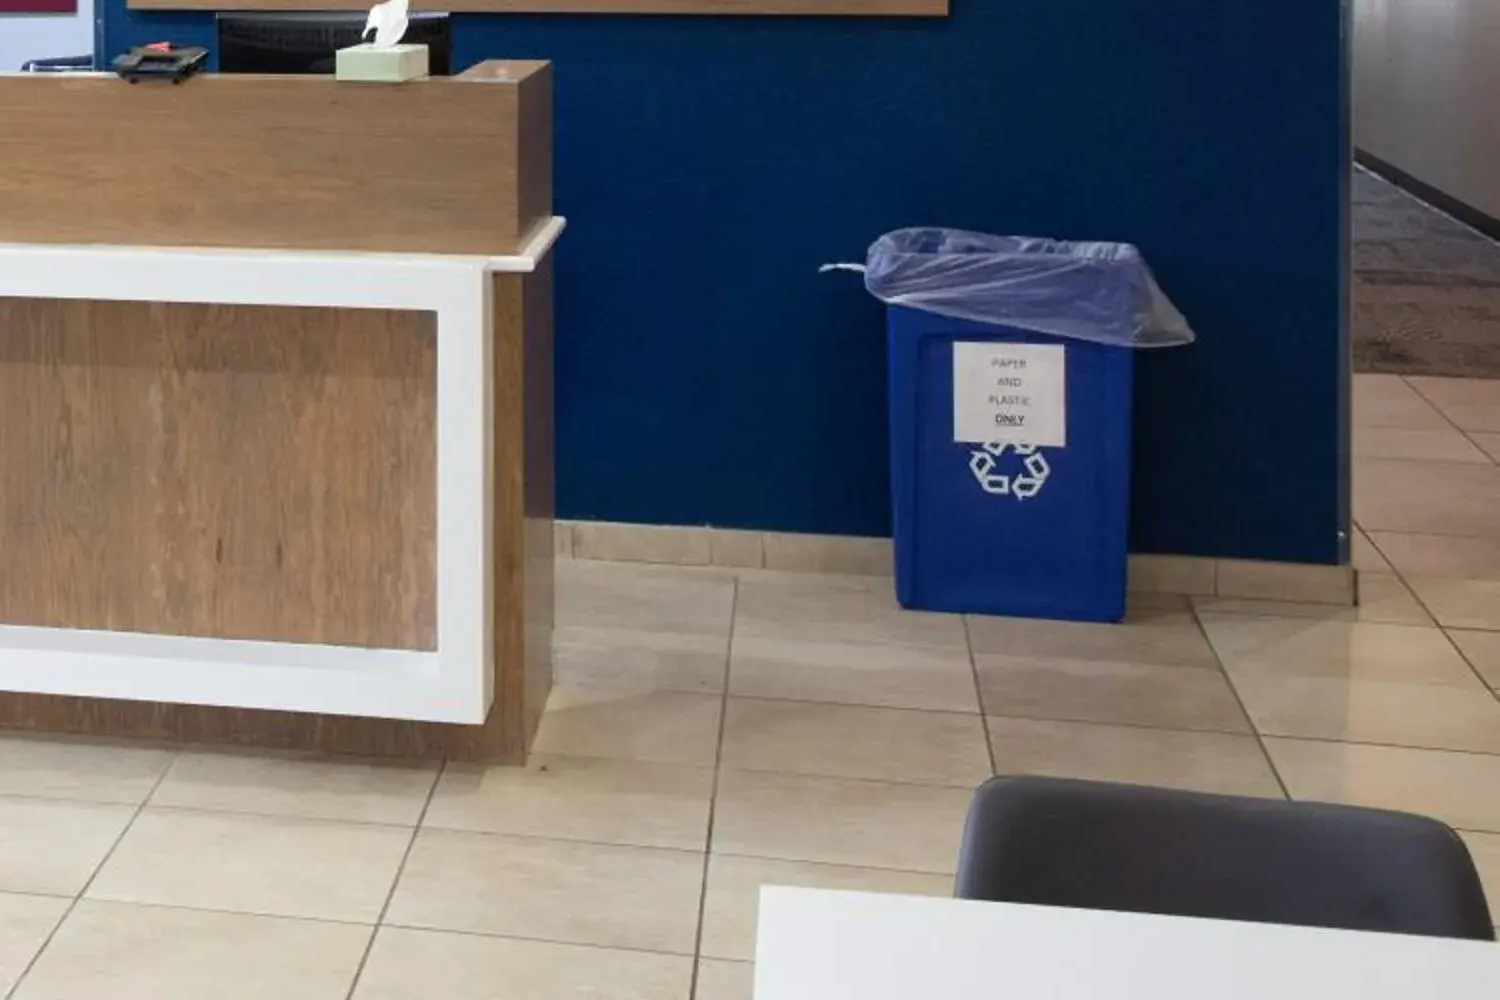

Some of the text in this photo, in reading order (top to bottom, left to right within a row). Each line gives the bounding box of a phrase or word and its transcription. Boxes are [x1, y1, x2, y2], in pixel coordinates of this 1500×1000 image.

[991, 357, 1027, 369] PAPER
[997, 377, 1022, 388] AND
[988, 395, 1030, 406] PLASTIC
[995, 414, 1025, 426] ONLY
